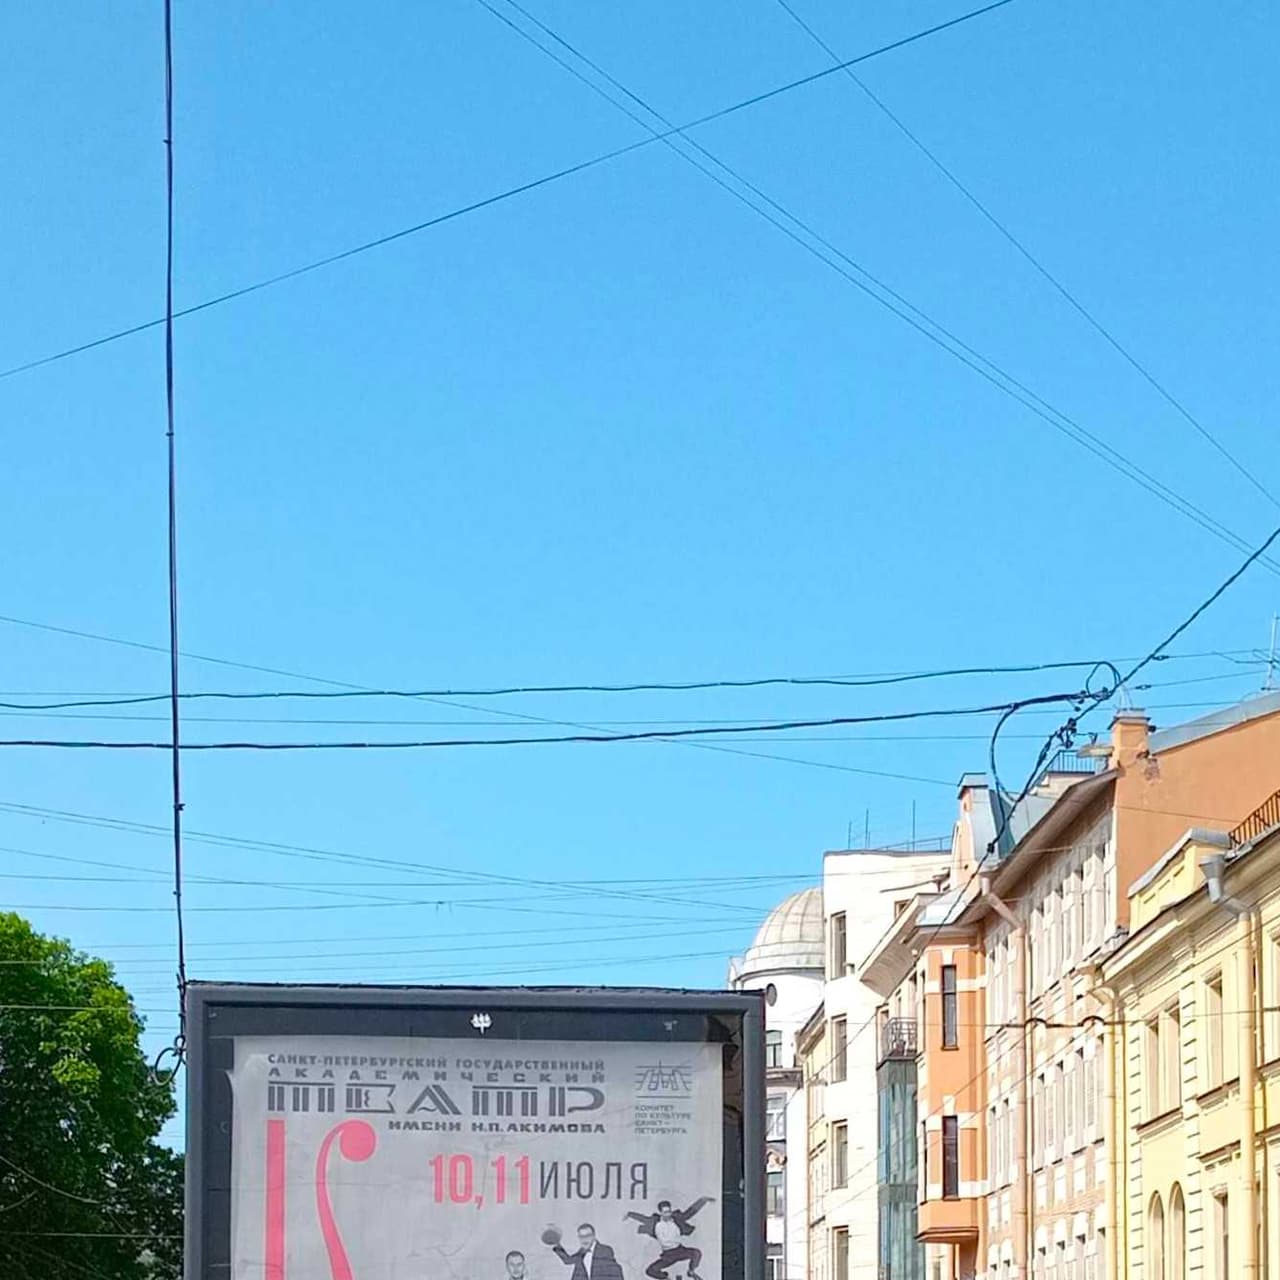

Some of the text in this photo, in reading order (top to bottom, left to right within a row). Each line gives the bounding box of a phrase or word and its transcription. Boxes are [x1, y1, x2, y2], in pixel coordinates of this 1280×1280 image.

[267, 1053, 606, 1072] САНКТ-ПЕТЕРБУРГСКИЙ ГОСУДАРСТВЕННЫЙ
[267, 1067, 606, 1084] АКАДЕМИЧЕСКИЙ
[267, 1080, 606, 1118] ТЕАТР
[388, 1120, 462, 1132] ИМЕНИ
[539, 1160, 648, 1200] ИЮЛЯ
